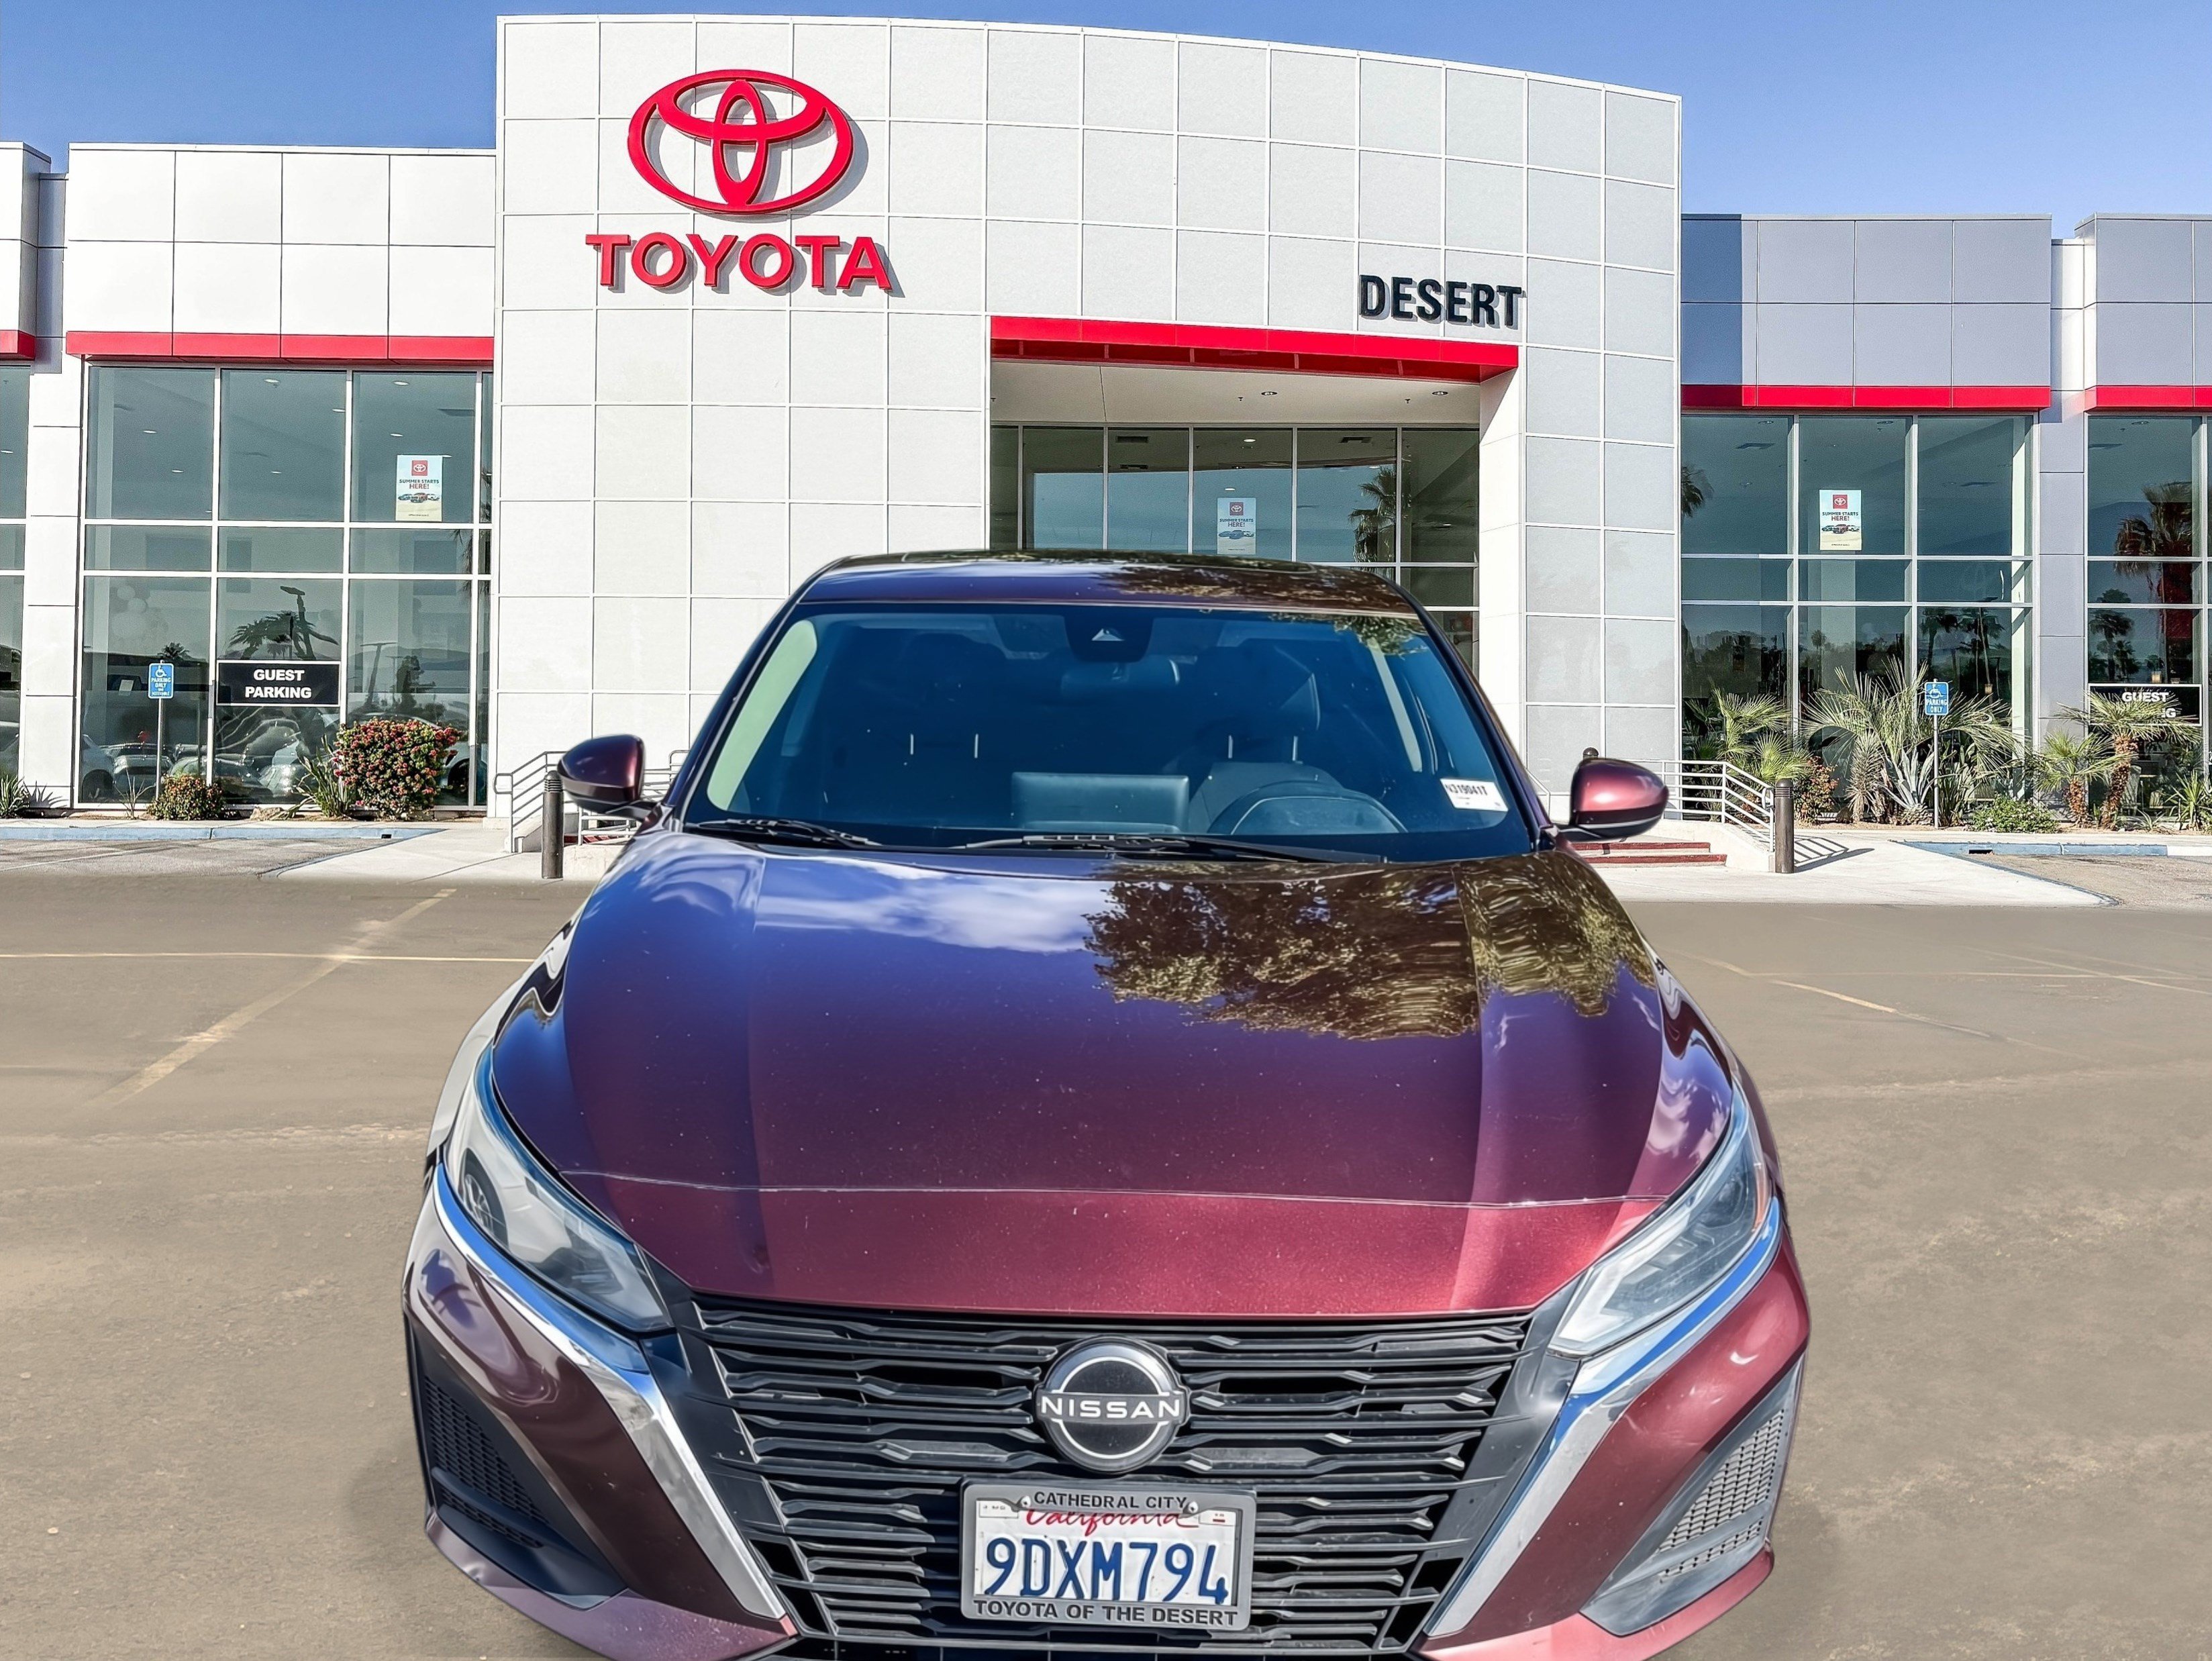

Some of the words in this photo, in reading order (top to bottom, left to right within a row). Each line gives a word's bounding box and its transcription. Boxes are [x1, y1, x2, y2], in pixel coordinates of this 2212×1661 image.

[585, 232, 893, 291] TOYOTA
[1359, 274, 1522, 327] DESERT
[253, 668, 305, 681] GUEST
[244, 686, 312, 699] PARKING
[2121, 691, 2169, 702] GUEST
[1041, 1396, 1180, 1419] NISSAN
[1034, 1491, 1140, 1509] CATHEDRAL
[1146, 1496, 1187, 1509] CITY
[985, 1536, 1229, 1605] 9DXM794
[973, 1599, 1058, 1618] TOYOTA
[1066, 1604, 1094, 1621] OF
[1102, 1605, 1145, 1623] THE
[1152, 1608, 1238, 1626] DESERT
